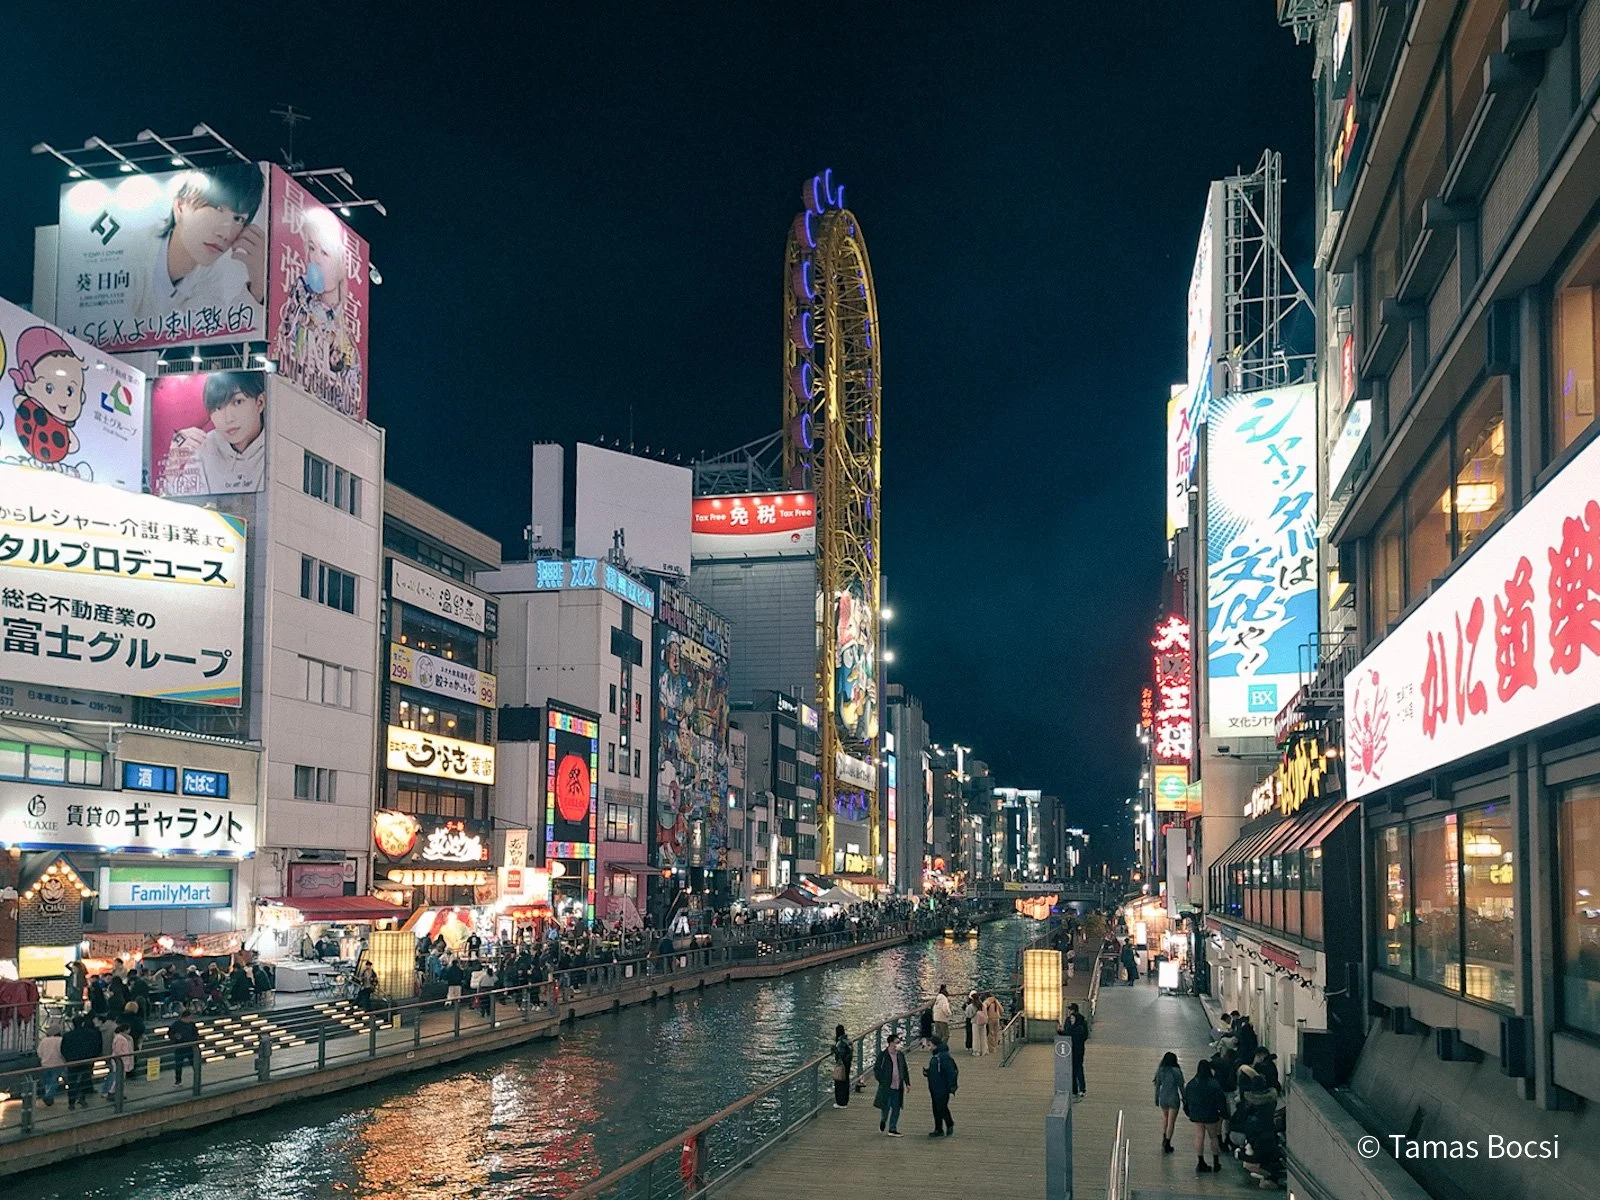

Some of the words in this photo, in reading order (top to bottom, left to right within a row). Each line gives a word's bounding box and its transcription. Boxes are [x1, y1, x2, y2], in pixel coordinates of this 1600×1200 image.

[710, 513, 727, 521] Free
[730, 504, 776, 526] 免税
[795, 508, 812, 517] Free
[0, 532, 228, 584] タルプロデュース
[536, 559, 597, 589] 無双
[2, 586, 157, 630] 総合不動産業の
[3, 617, 233, 679] 富士グループ
[1251, 690, 1275, 706] BX
[406, 737, 469, 775] うなぎ
[138, 768, 153, 788] 酒
[185, 774, 217, 794] たばこ
[67, 802, 243, 843] 賃貸のギャラント
[131, 885, 211, 904] FamilyMart
